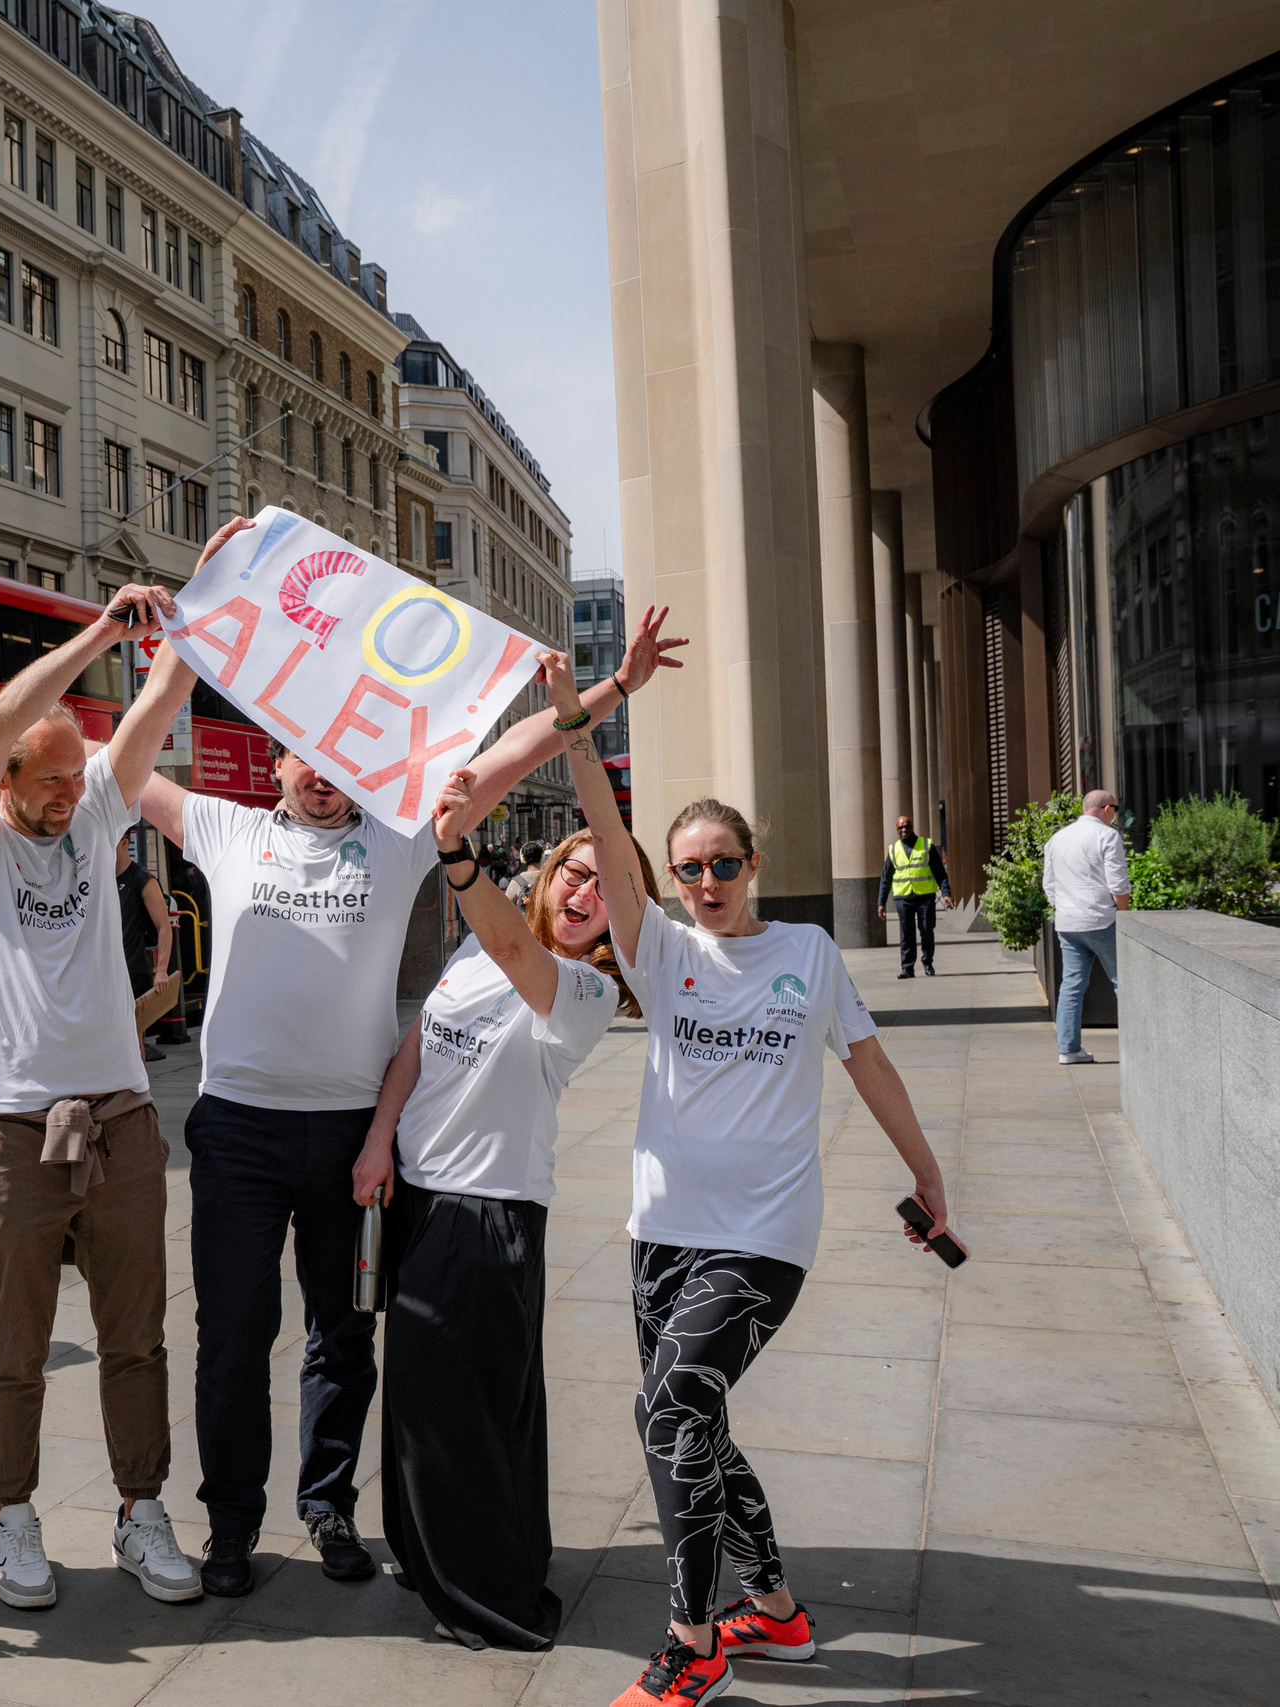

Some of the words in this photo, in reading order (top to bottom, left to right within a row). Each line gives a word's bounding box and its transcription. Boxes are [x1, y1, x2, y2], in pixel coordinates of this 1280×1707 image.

[1254, 592, 1280, 633] C
[168, 595, 475, 821] ALEX
[23, 878, 43, 890] eather
[251, 882, 369, 908] Weather
[17, 881, 91, 919] Weathe
[19, 911, 77, 930] Wisdom
[253, 903, 318, 923] Wisdom
[326, 910, 365, 923] wins
[678, 989, 717, 1004] OpenWther
[766, 1007, 807, 1020] Weather
[674, 1015, 796, 1049] Weather
[422, 1034, 456, 1061] isdom
[744, 1048, 785, 1066] wins
